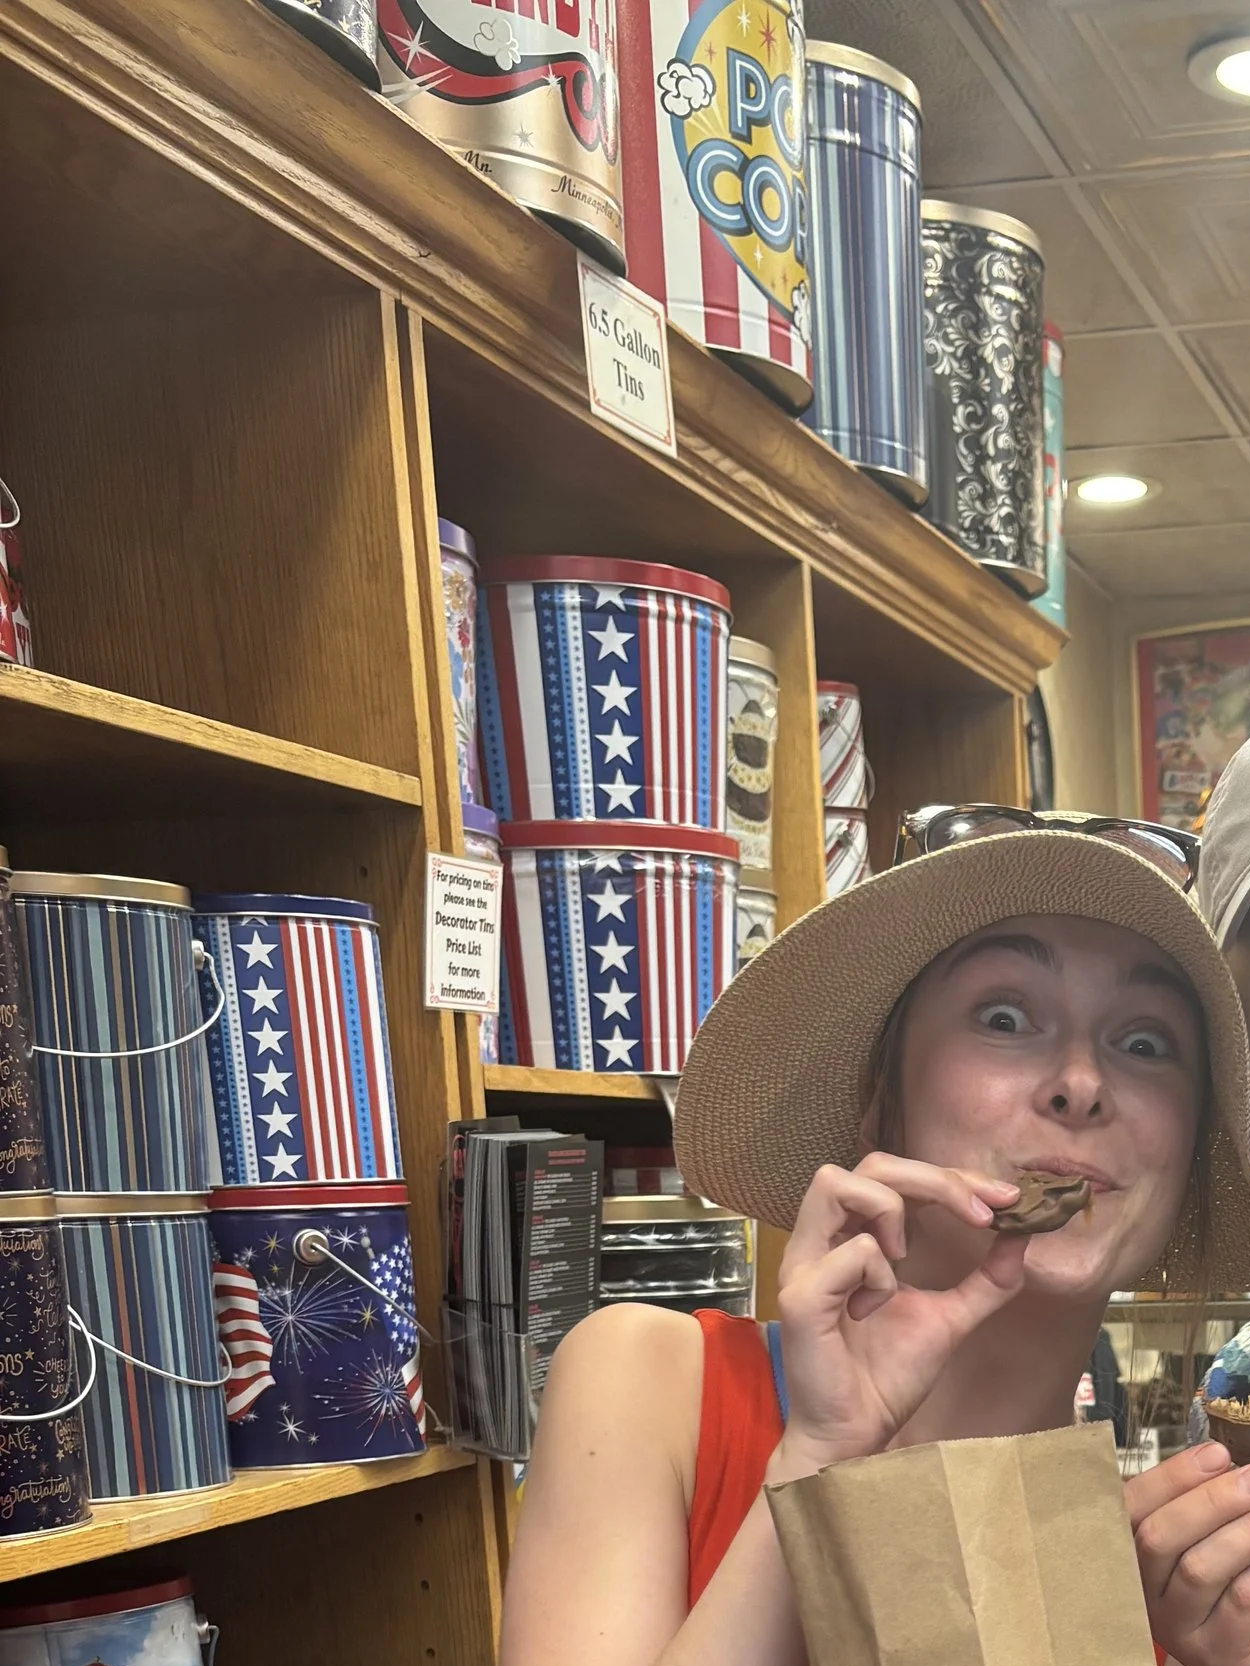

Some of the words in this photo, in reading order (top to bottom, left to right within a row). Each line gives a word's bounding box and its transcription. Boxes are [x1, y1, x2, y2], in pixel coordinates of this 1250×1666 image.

[588, 302, 610, 338] 6.5
[613, 318, 661, 370] Gallon
[613, 358, 645, 401] Tins
[436, 869, 449, 883] For
[449, 873, 472, 890] pricing
[473, 879, 482, 890] on
[482, 879, 494, 892] tins
[443, 892, 465, 905] please
[465, 897, 475, 908] see
[477, 897, 488, 910] the
[435, 911, 477, 931] Decorator
[479, 918, 495, 934] Tins
[446, 938, 466, 954] Price
[467, 940, 482, 956] List
[448, 962, 460, 976] for
[461, 967, 480, 979] more
[440, 983, 486, 1000] information
